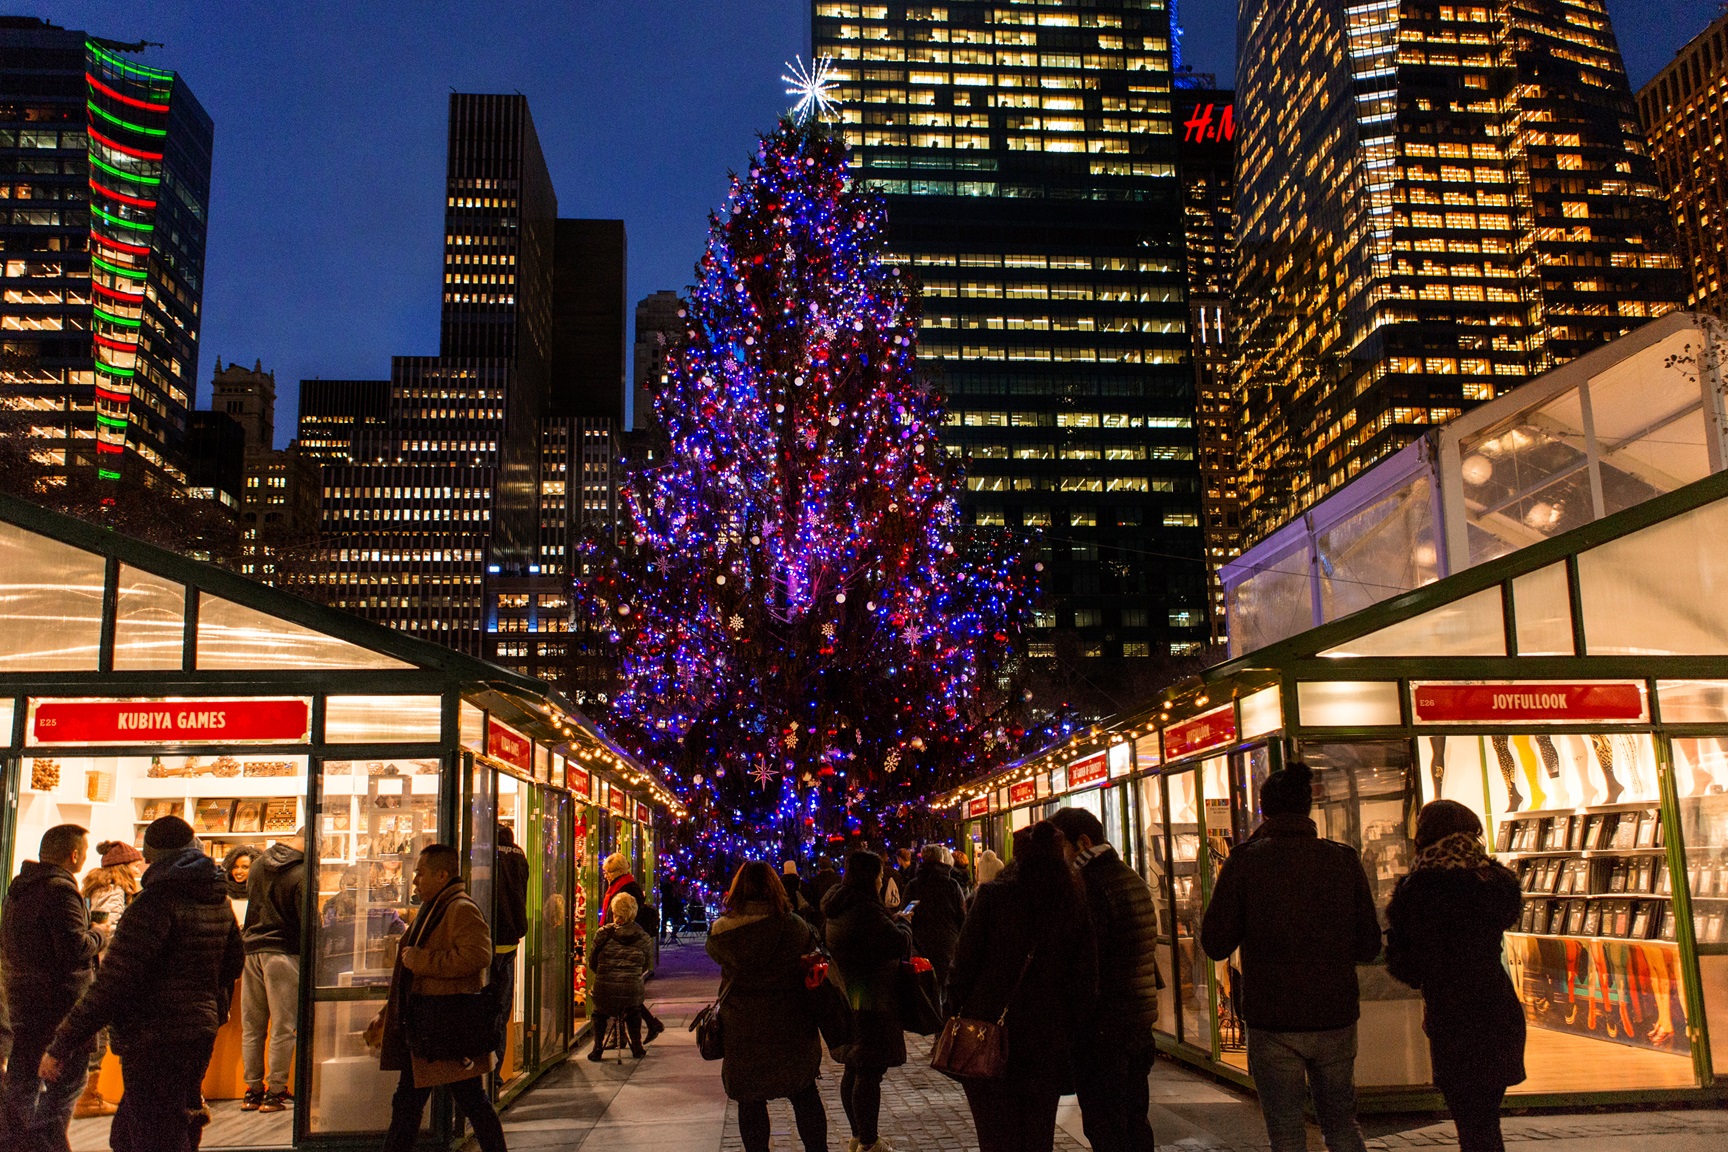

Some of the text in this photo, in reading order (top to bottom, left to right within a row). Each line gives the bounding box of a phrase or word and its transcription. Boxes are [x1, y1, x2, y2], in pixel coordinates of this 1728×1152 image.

[1419, 699, 1435, 707] E26
[1492, 693, 1568, 710] JOYFULLOOK
[39, 718, 57, 727] E25
[117, 711, 226, 730] KUBIYA GAMES
